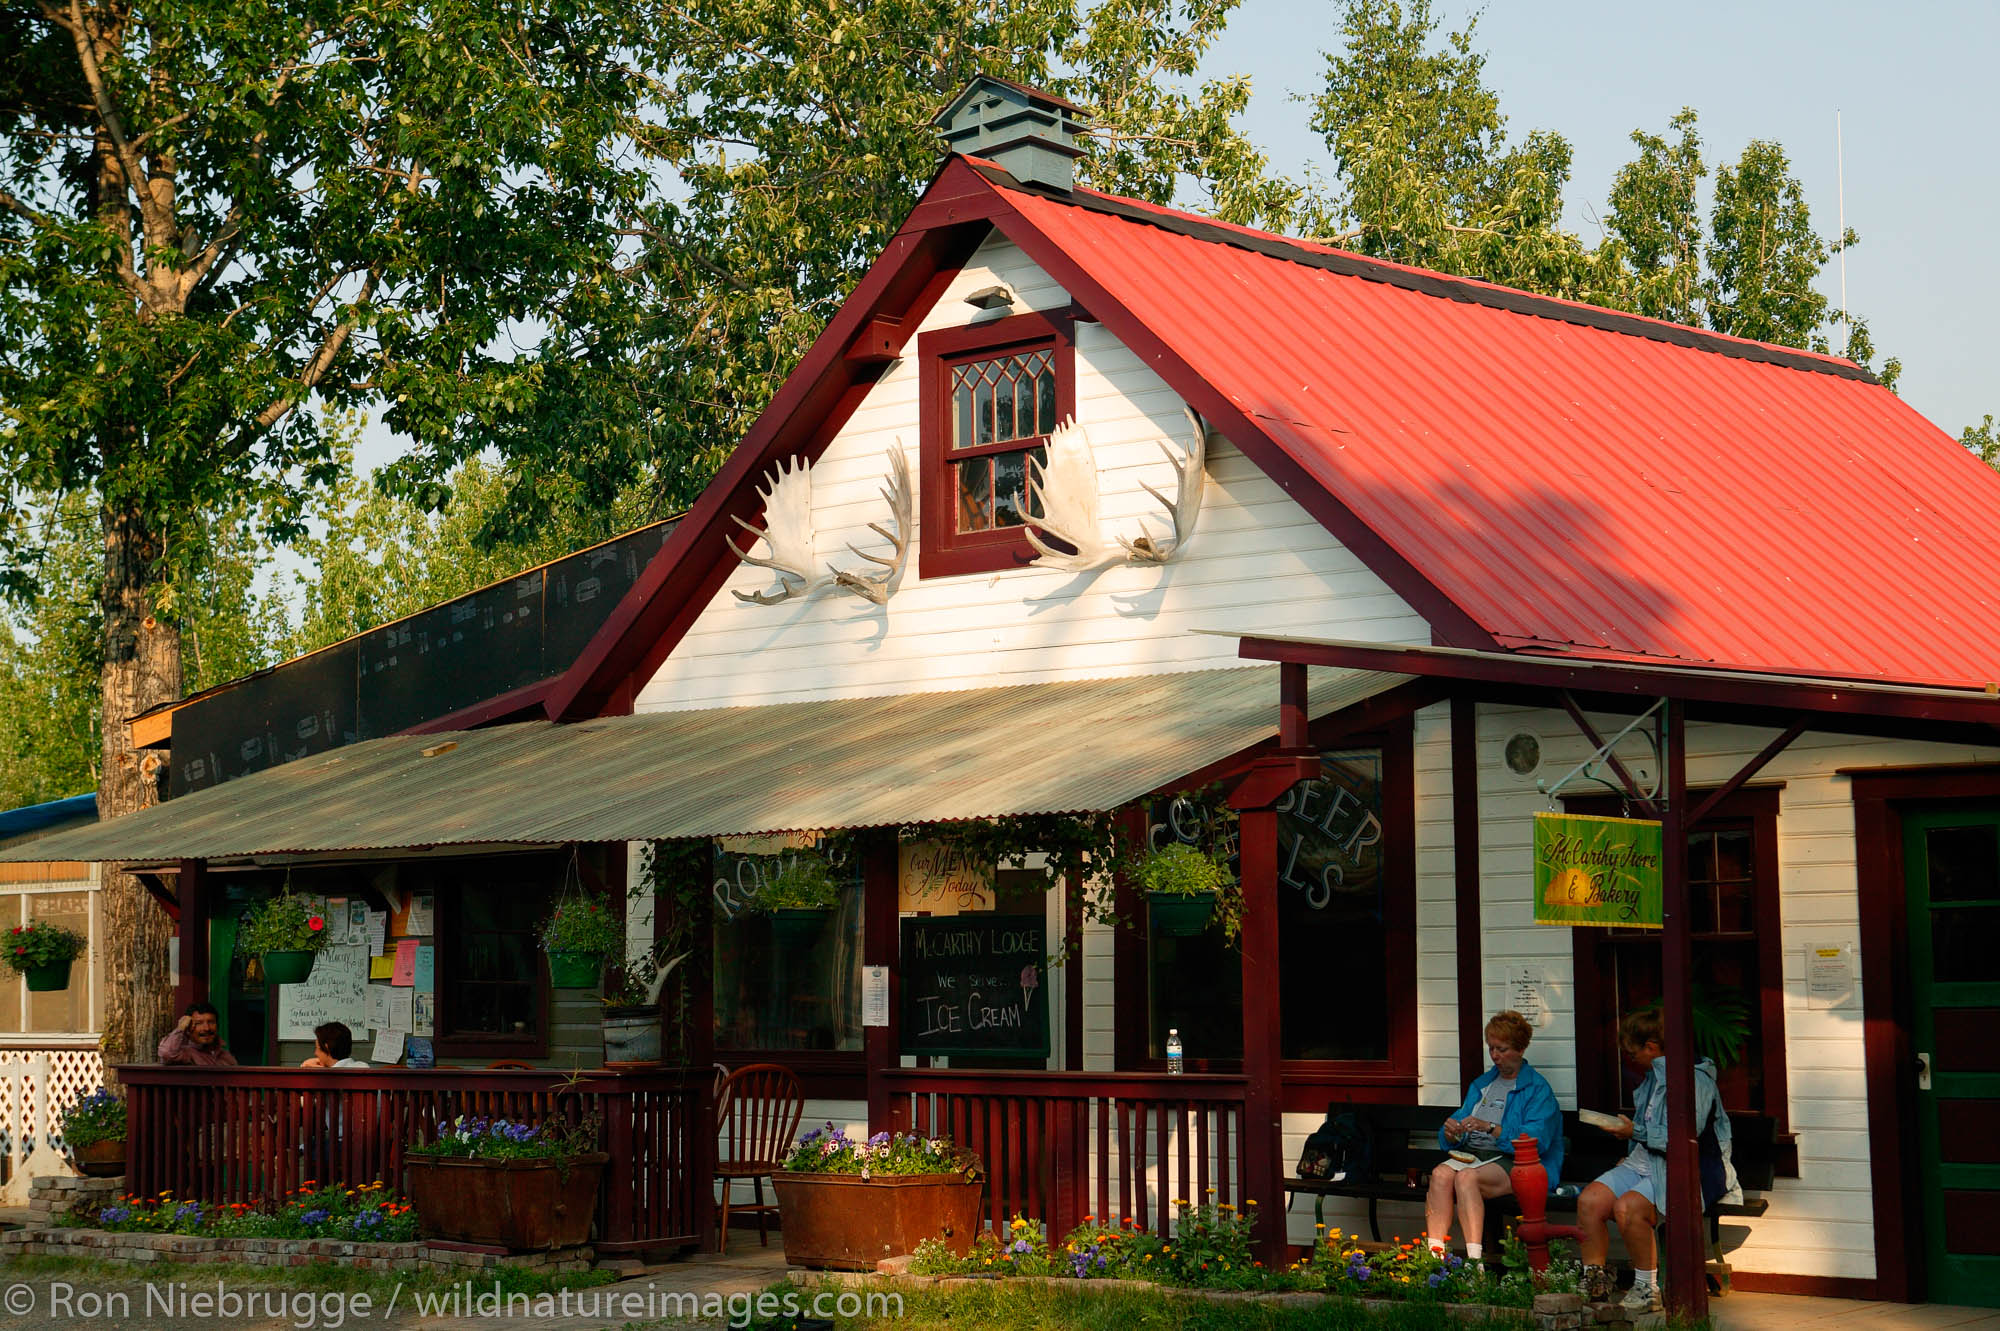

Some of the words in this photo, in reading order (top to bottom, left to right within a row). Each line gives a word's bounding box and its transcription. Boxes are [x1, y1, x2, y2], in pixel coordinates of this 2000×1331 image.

[1543, 833, 1619, 882] McCarthy
[1620, 840, 1658, 868] Store
[936, 875, 986, 908] Today
[1568, 874, 1578, 900] &
[1584, 874, 1641, 920] Bakery
[991, 928, 1041, 955] LODGE
[917, 995, 963, 1037] ICE
[967, 991, 1023, 1031] CREAM
